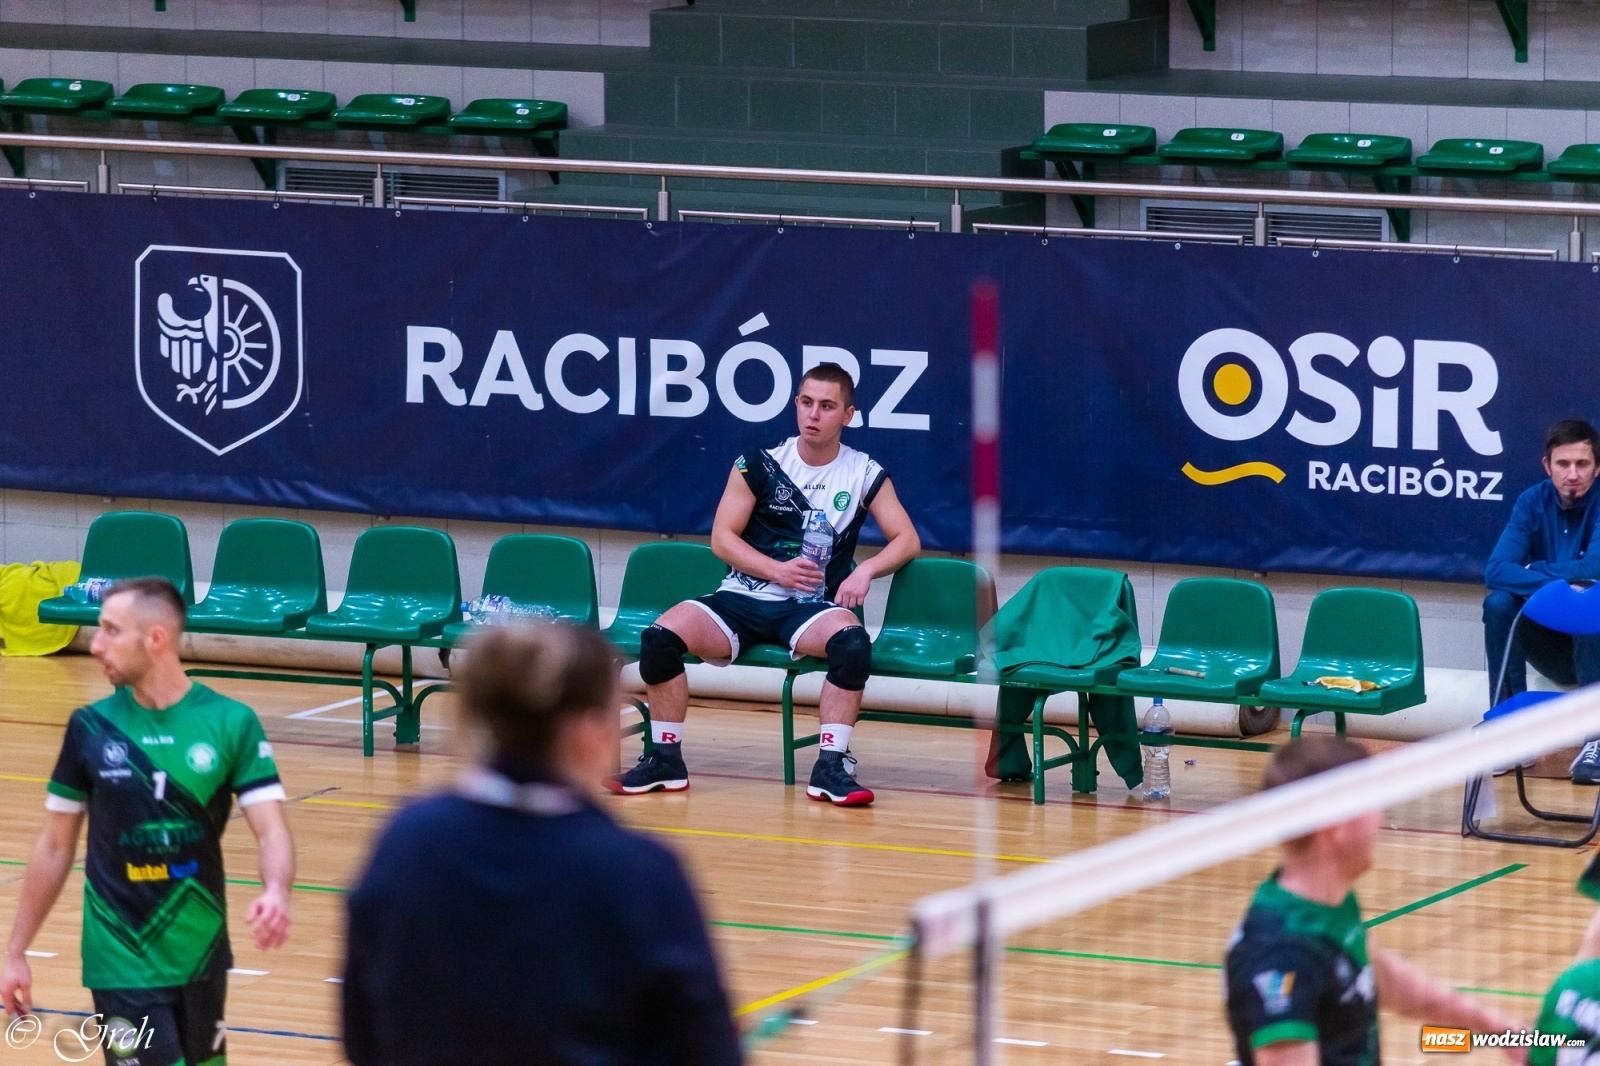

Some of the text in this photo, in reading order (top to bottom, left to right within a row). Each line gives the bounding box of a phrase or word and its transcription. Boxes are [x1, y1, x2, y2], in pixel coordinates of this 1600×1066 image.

[1308, 458, 1504, 501] RACIBÓRZ
[661, 732, 677, 743] R
[821, 733, 834, 743] R
[152, 770, 167, 801] 1
